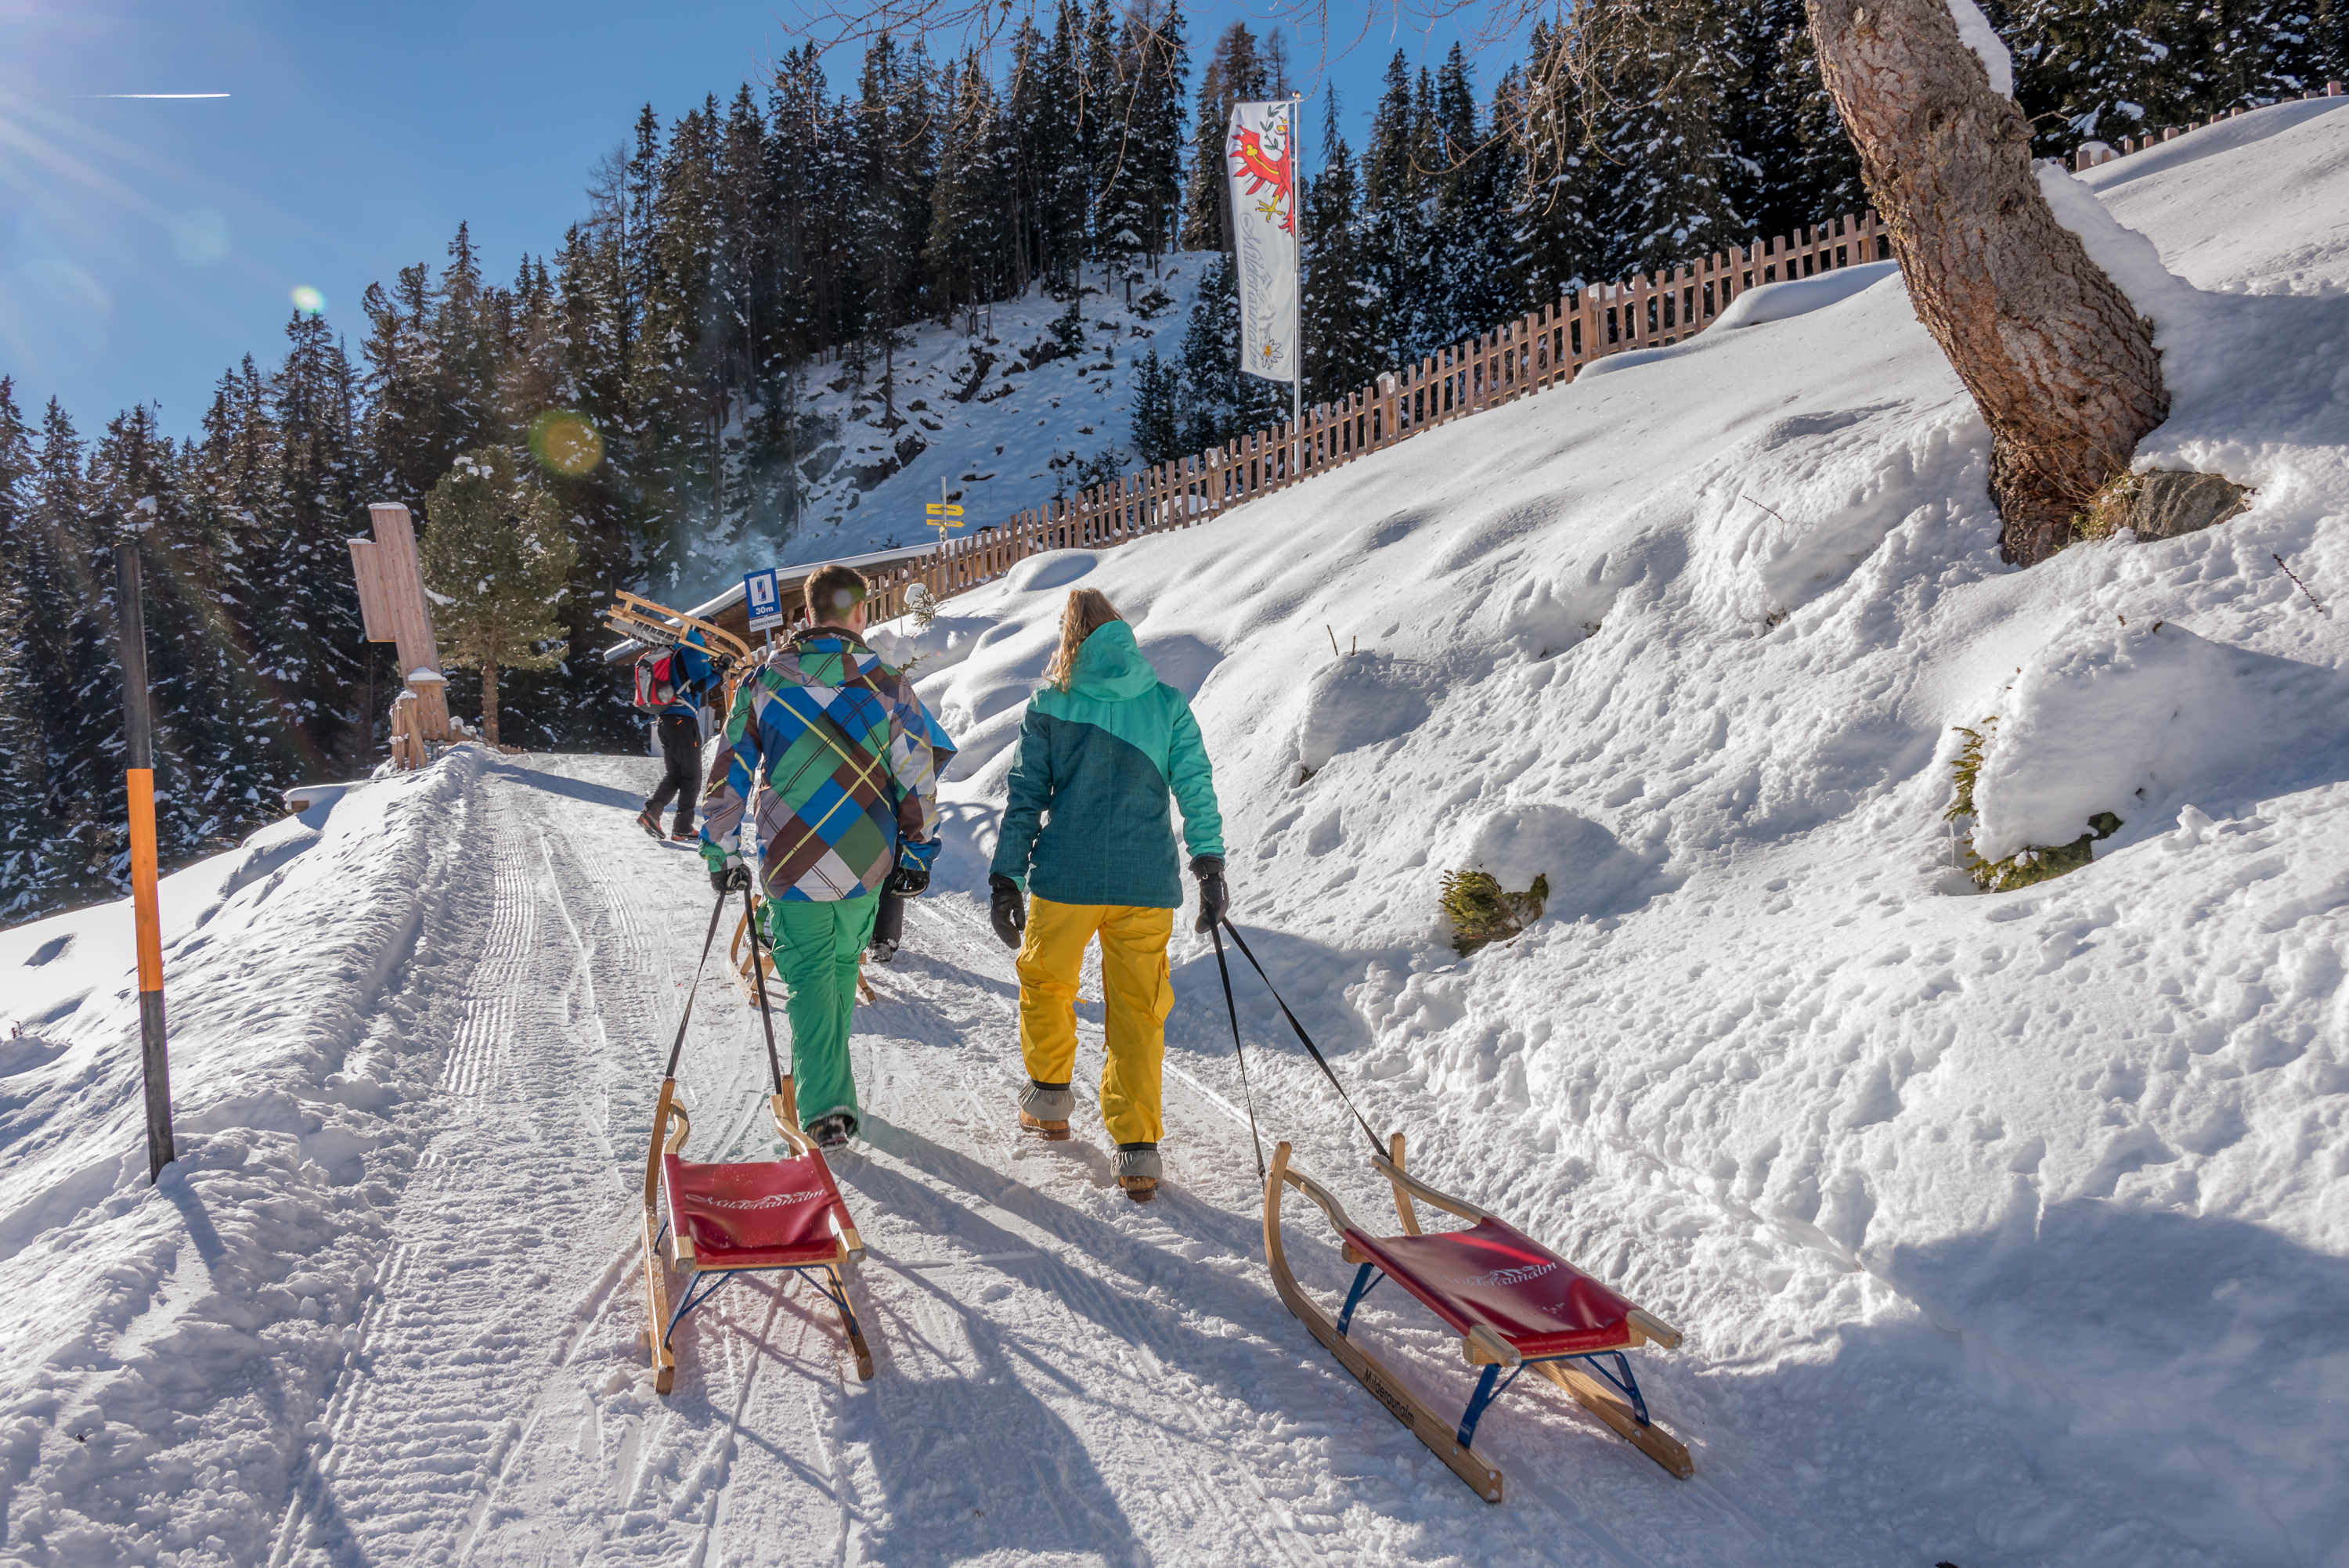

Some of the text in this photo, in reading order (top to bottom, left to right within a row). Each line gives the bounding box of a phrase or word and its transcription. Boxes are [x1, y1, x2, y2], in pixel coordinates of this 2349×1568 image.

[755, 606, 774, 615] 30m
[750, 617, 782, 629] FLÜGELVERLEIH
[685, 1188, 824, 1210] Milderaunalm
[1424, 1261, 1557, 1287] Milderaunalm
[1363, 1367, 1415, 1426] Milderaunalm
